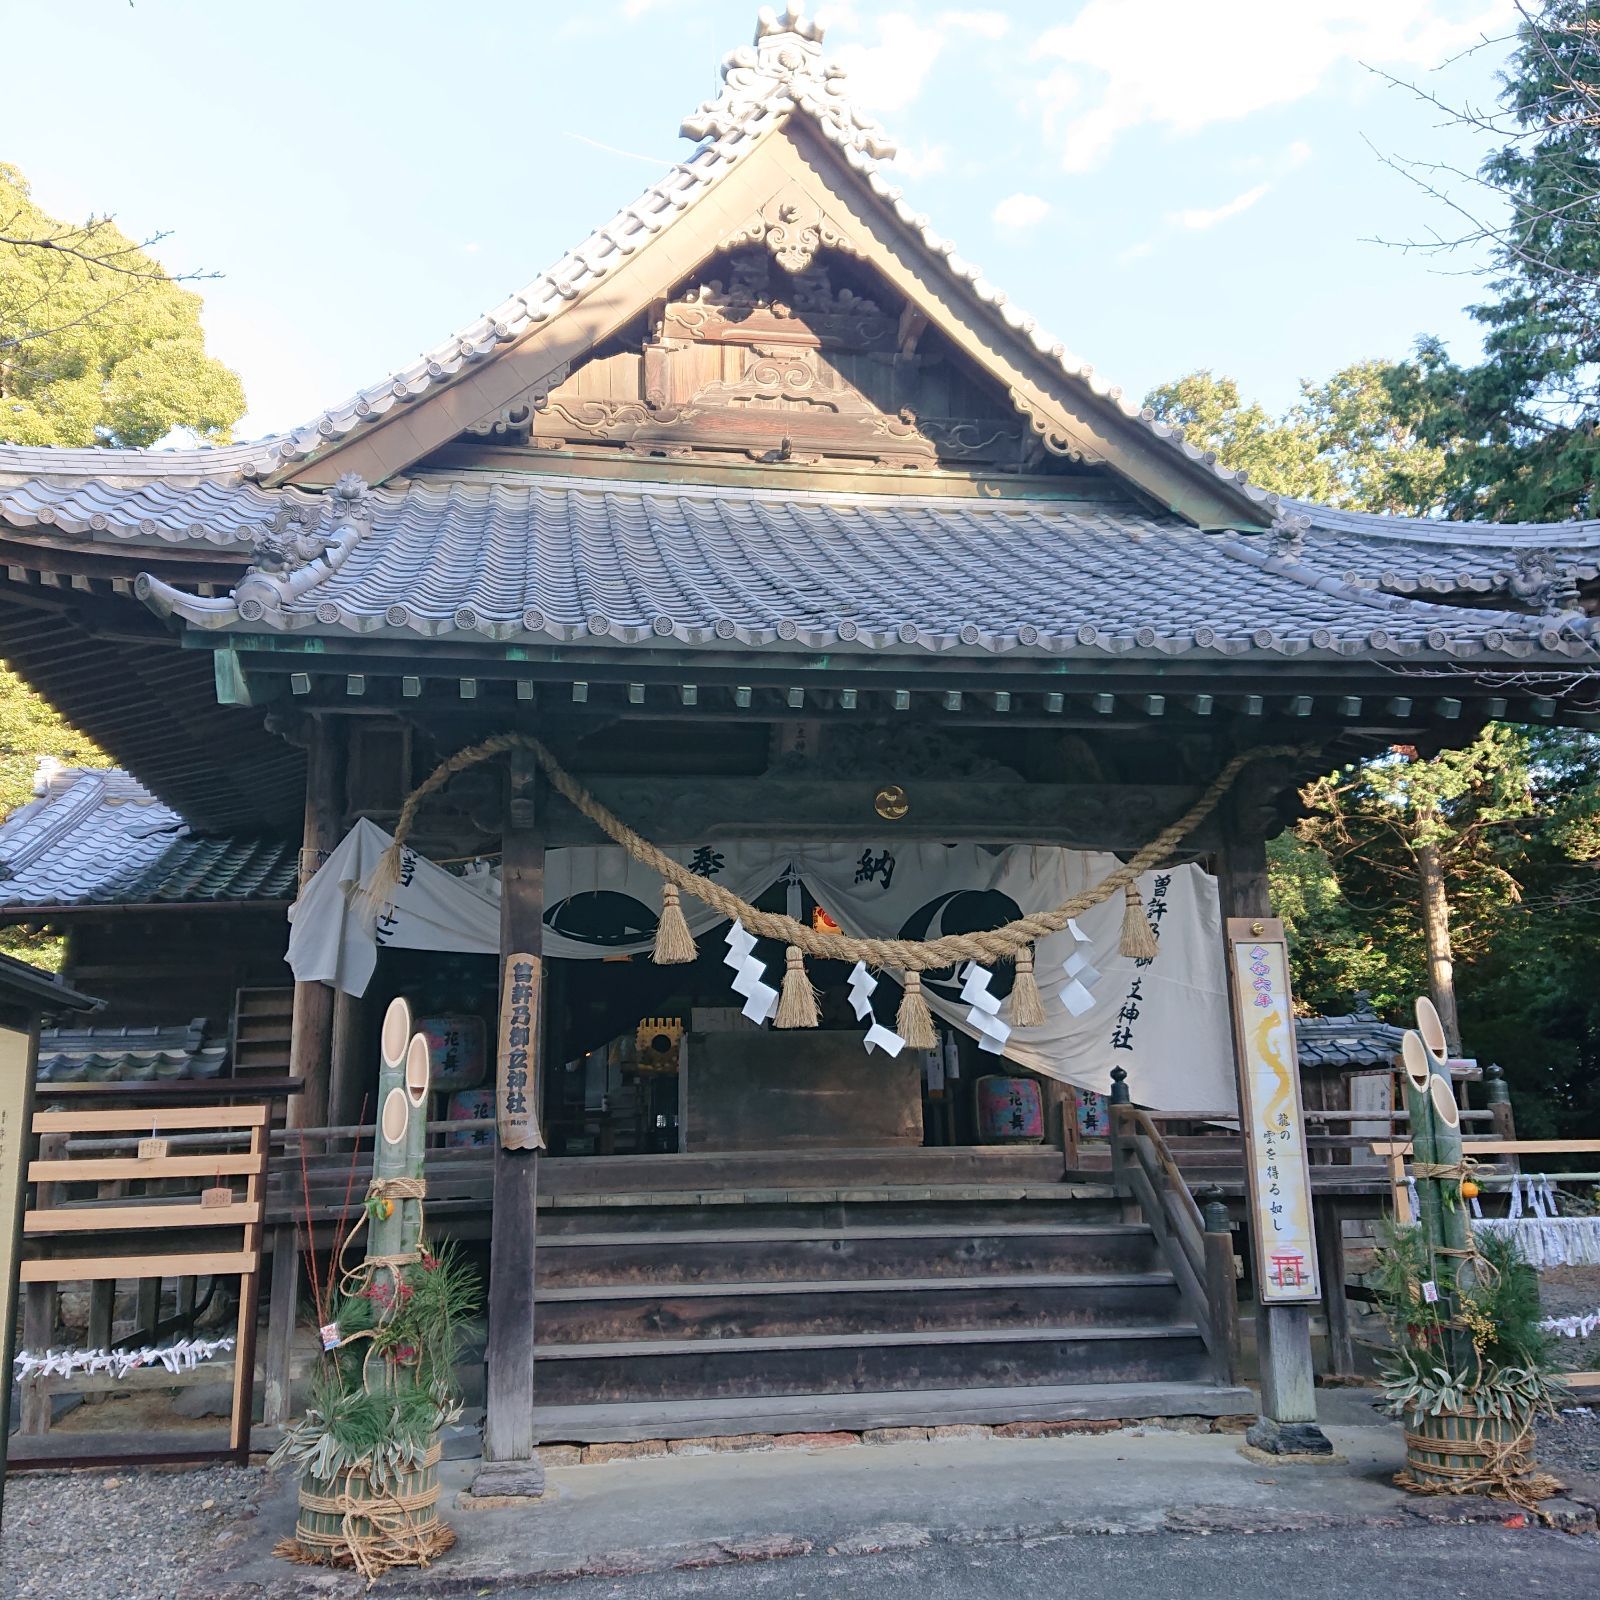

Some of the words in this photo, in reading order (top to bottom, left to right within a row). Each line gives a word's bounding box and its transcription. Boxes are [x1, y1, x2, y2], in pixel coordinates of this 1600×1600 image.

[687, 845, 726, 880] 奉
[853, 848, 896, 890] 納
[1249, 945, 1274, 1008] 令和六年
[472, 1103, 489, 1145] 花舞
[1008, 1091, 1025, 1131] 花の舞
[1082, 1090, 1099, 1131] 花の舞
[1276, 1112, 1291, 1141] 龍の
[1263, 1130, 1283, 1231] 雲を得る如し
